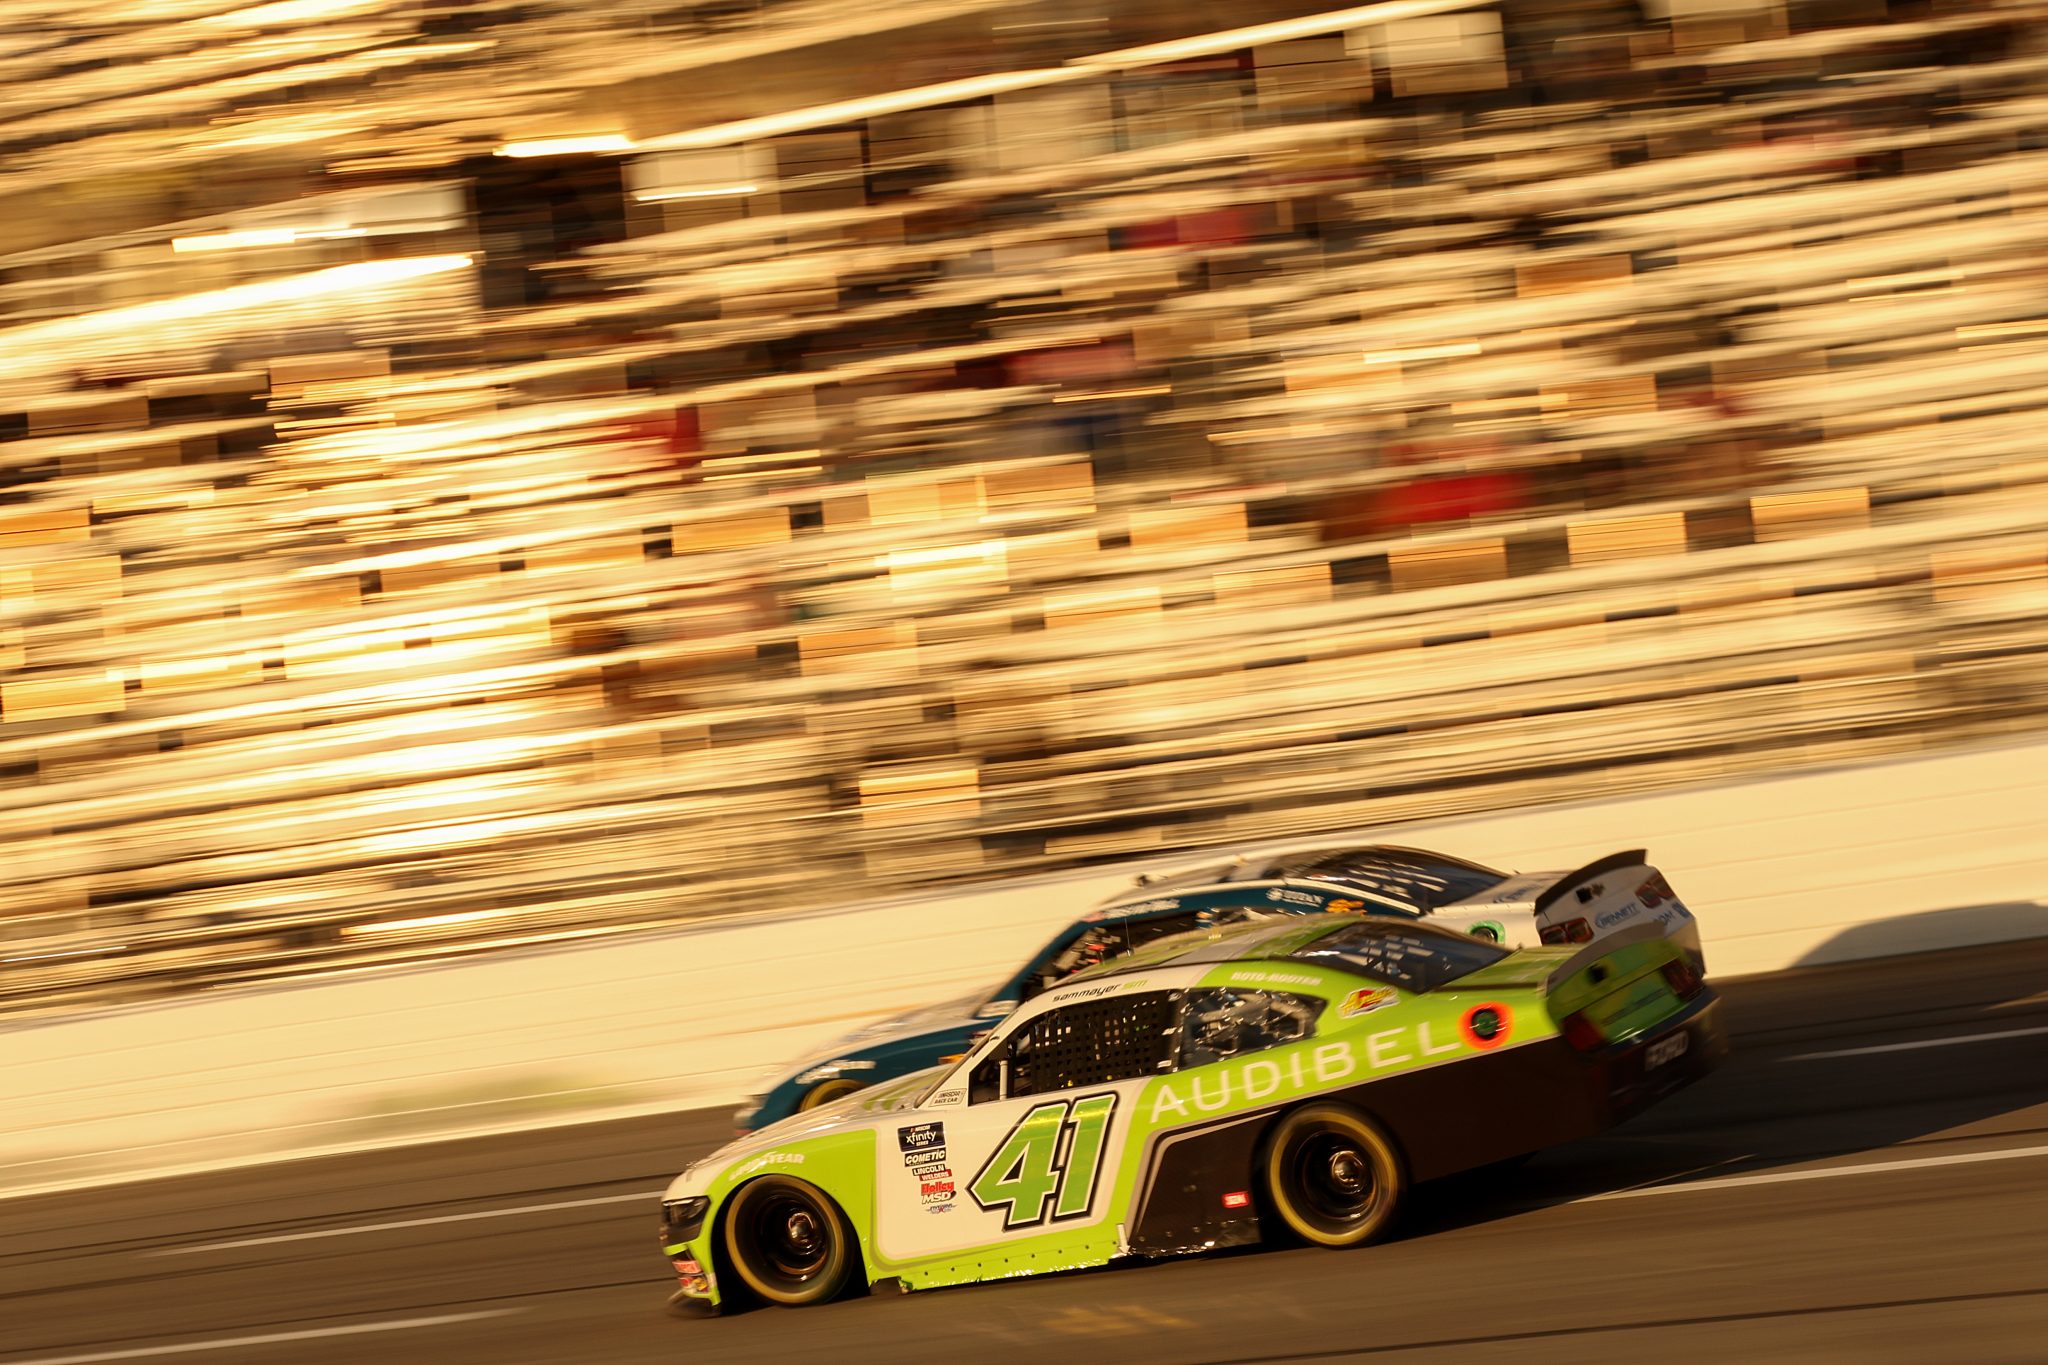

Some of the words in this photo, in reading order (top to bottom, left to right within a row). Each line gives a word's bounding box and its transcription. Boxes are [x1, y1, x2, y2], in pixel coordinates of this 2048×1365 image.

[1053, 984, 1122, 1001] sammayer
[1150, 1021, 1462, 1123] AUDIBEL
[906, 1131, 936, 1145] xfinity
[905, 1150, 945, 1165] COMETIC
[966, 1090, 1120, 1232] 41
[913, 1164, 945, 1175] LINCOLN
[921, 1171, 950, 1180] WELDERS
[921, 1181, 954, 1193] Holley
[922, 1192, 952, 1203] MSD
